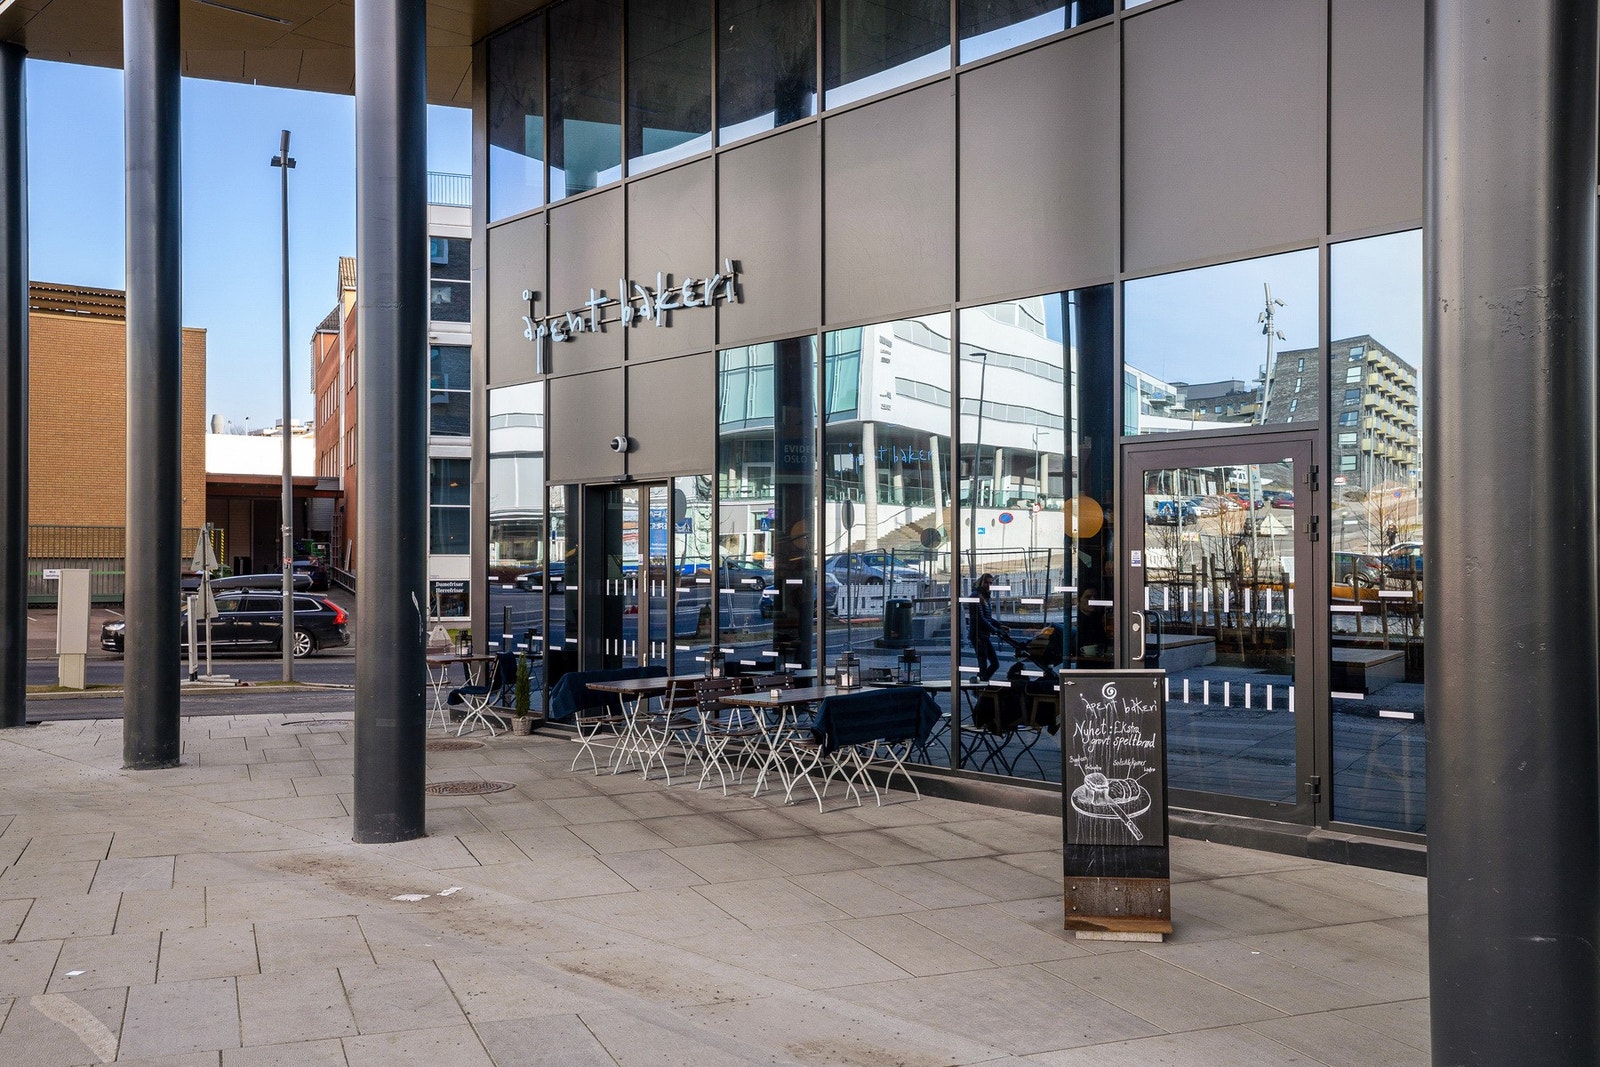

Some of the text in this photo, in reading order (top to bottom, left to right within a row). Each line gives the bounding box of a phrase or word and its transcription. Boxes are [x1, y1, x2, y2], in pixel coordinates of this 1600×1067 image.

[522, 257, 735, 374] åpent bakeri
[784, 454, 808, 463] OSLO
[1080, 693, 1118, 718] åpent
